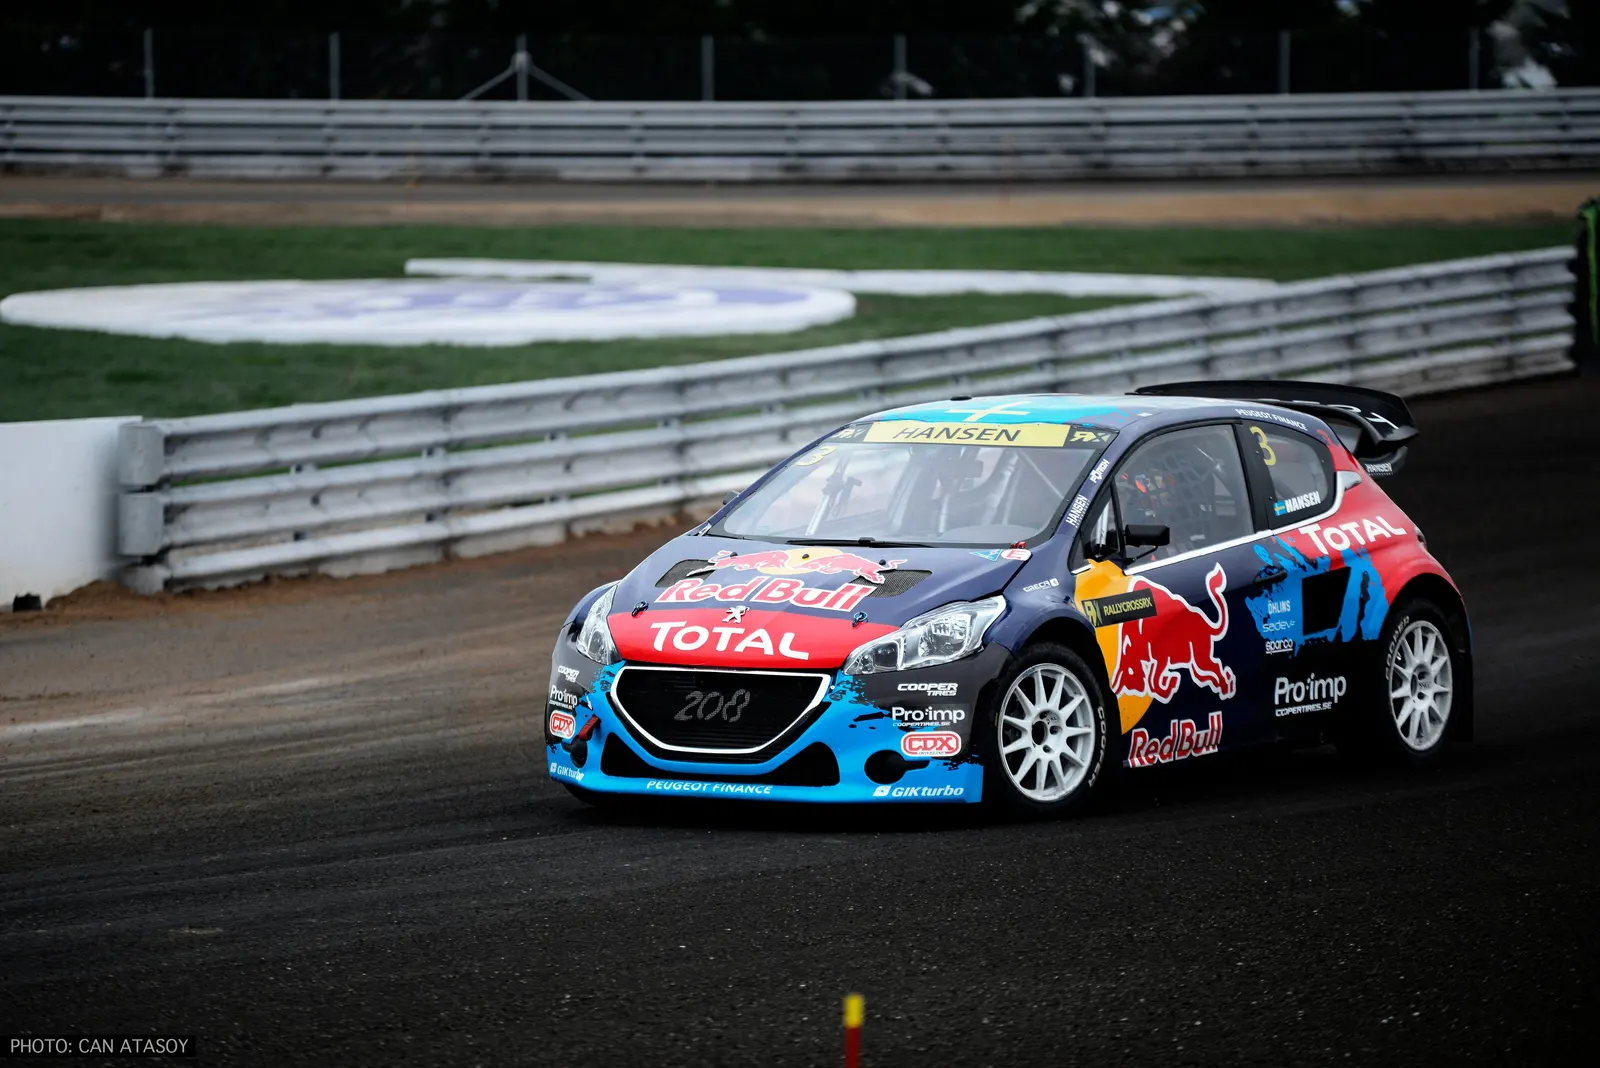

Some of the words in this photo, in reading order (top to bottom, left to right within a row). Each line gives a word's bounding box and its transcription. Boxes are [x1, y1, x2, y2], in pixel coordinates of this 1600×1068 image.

[1235, 408, 1272, 420] PEUGEOT
[1271, 413, 1309, 431] FINANCE
[892, 427, 1021, 442] HANSEN
[1249, 426, 1276, 466] 3
[796, 446, 836, 466] 3
[1365, 462, 1392, 473] HANSEN
[1066, 493, 1088, 526] HANSEN
[1284, 491, 1321, 513] HANSEN
[1298, 516, 1407, 555] TOTAL
[654, 576, 771, 602] Red
[749, 578, 877, 612] Bull
[1103, 597, 1153, 616] RALLYCROSSRX
[1268, 599, 1291, 614] ÖHLINS
[650, 621, 809, 660] TOTAL
[1265, 638, 1293, 655] sparco
[557, 665, 579, 677] COOPER
[897, 683, 958, 691] COOPER
[674, 689, 750, 722] 208
[552, 716, 573, 734] CDX
[908, 737, 955, 751] CDX
[1128, 719, 1178, 768] Red
[1175, 711, 1223, 760] Bull
[646, 780, 710, 791] PEUGEOT
[712, 783, 773, 794] FINANCE
